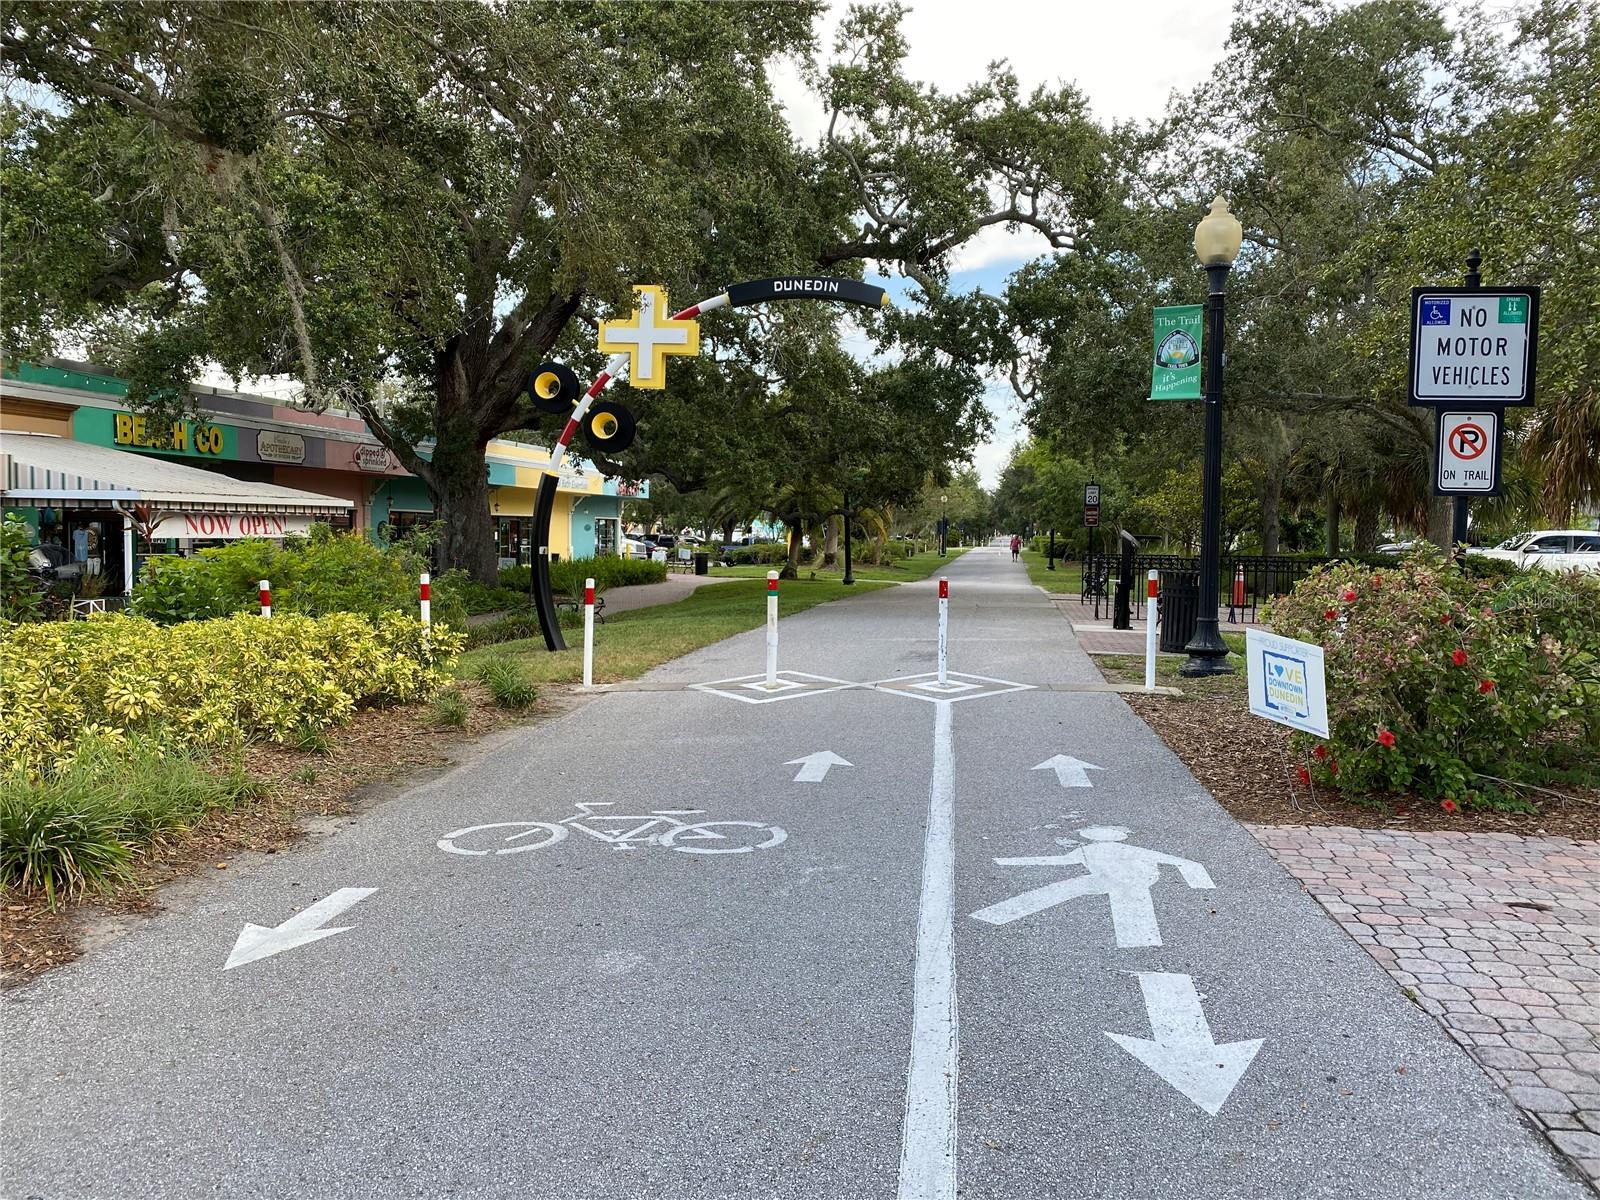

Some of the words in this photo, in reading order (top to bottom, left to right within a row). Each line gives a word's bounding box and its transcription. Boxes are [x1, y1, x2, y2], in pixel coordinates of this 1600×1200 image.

[774, 280, 839, 293] DUNEDIN
[1157, 316, 1177, 326] The
[1178, 314, 1201, 325] Trail
[1460, 308, 1487, 328] NO
[1437, 337, 1508, 356] MOTOR
[1155, 375, 1198, 392] Happening
[1162, 371, 1176, 383] it's
[1432, 366, 1510, 385] VEHICLES
[115, 412, 188, 450] BEH
[195, 424, 224, 455] CO
[360, 446, 380, 458] dipped
[1443, 470, 1456, 480] ON
[1464, 470, 1489, 481] TRAIL
[1087, 495, 1098, 503] 20
[184, 513, 233, 535] NOW
[239, 512, 289, 536] OPEN!
[1268, 677, 1303, 694] DOWNTOWN
[1268, 687, 1304, 706] DUNEDIN
